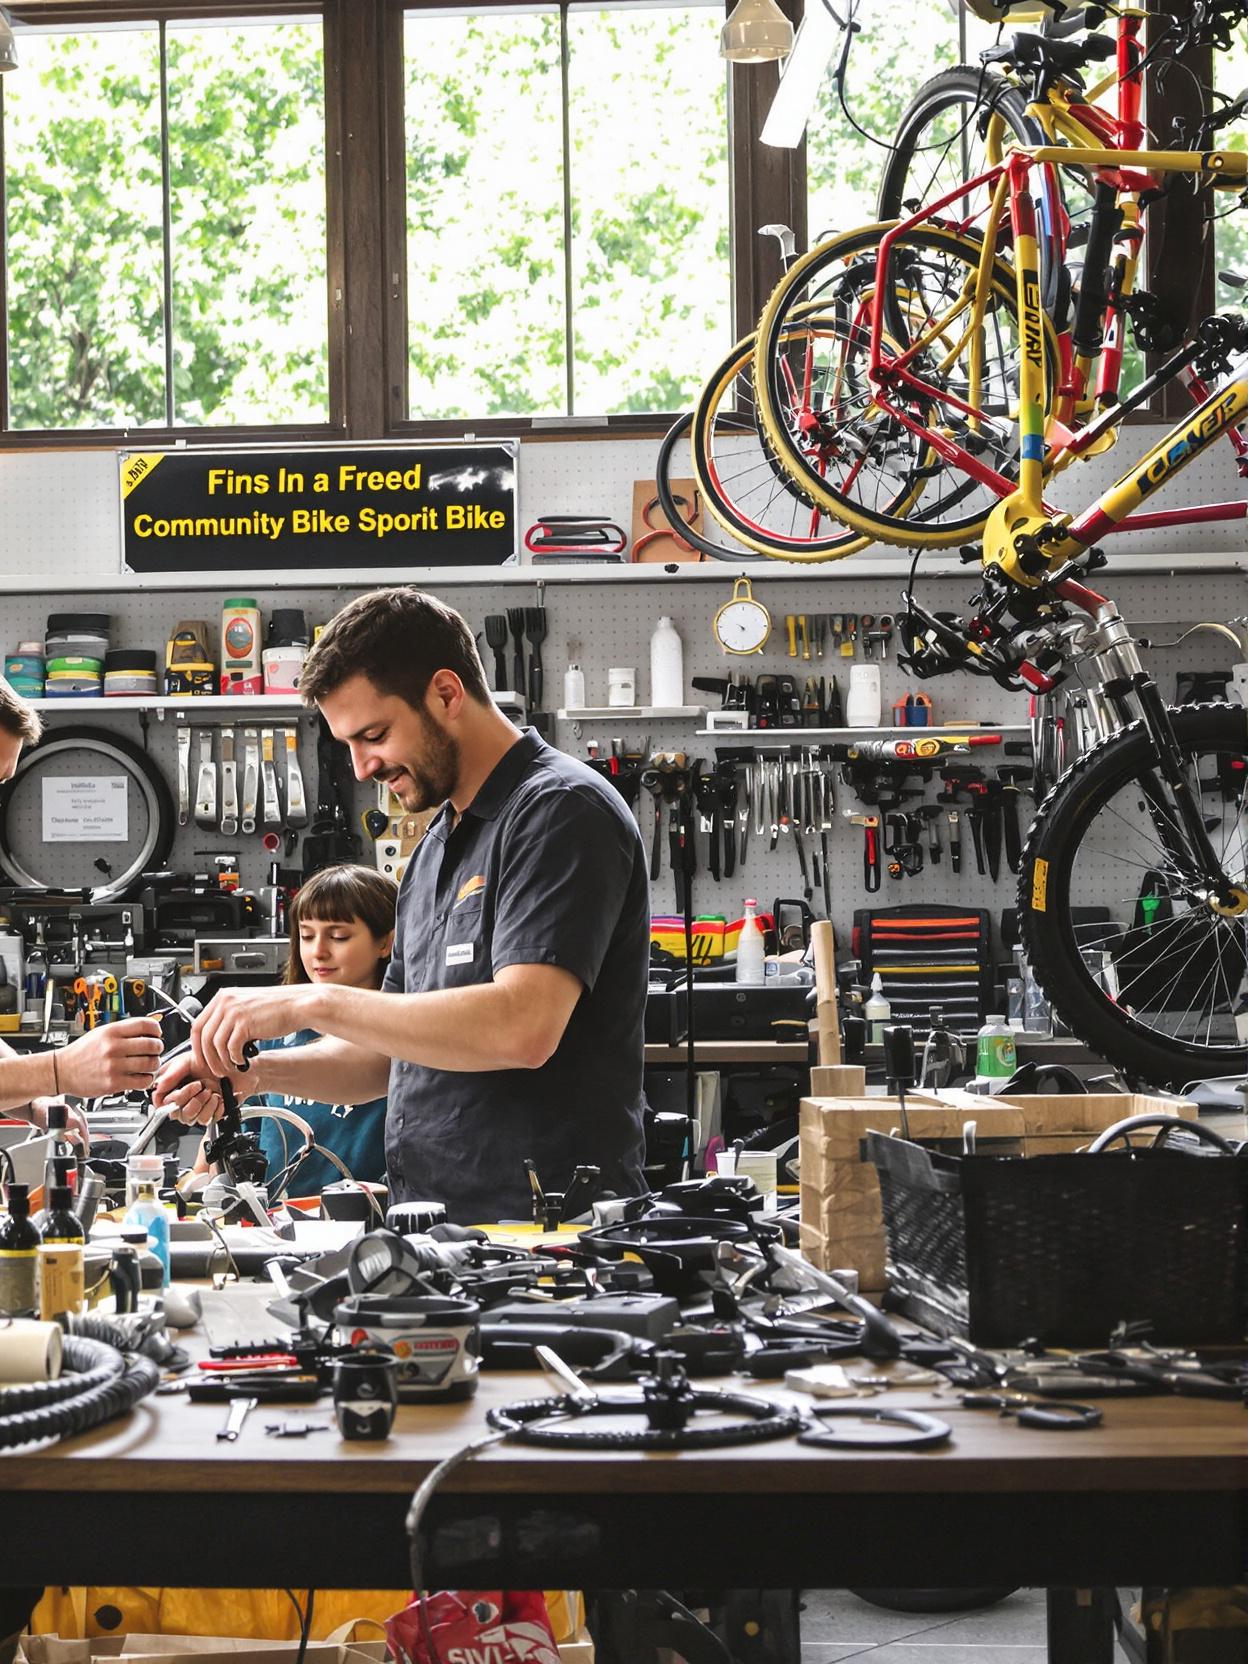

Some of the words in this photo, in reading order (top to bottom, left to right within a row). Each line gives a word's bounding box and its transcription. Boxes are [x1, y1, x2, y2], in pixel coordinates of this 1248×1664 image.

[208, 469, 270, 495] Fins
[278, 467, 304, 493] In
[313, 472, 329, 493] a
[338, 463, 422, 491] Freed
[133, 510, 285, 540] Community
[292, 509, 350, 533] Bike
[358, 506, 439, 537] Sporit
[446, 505, 505, 529] Bike
